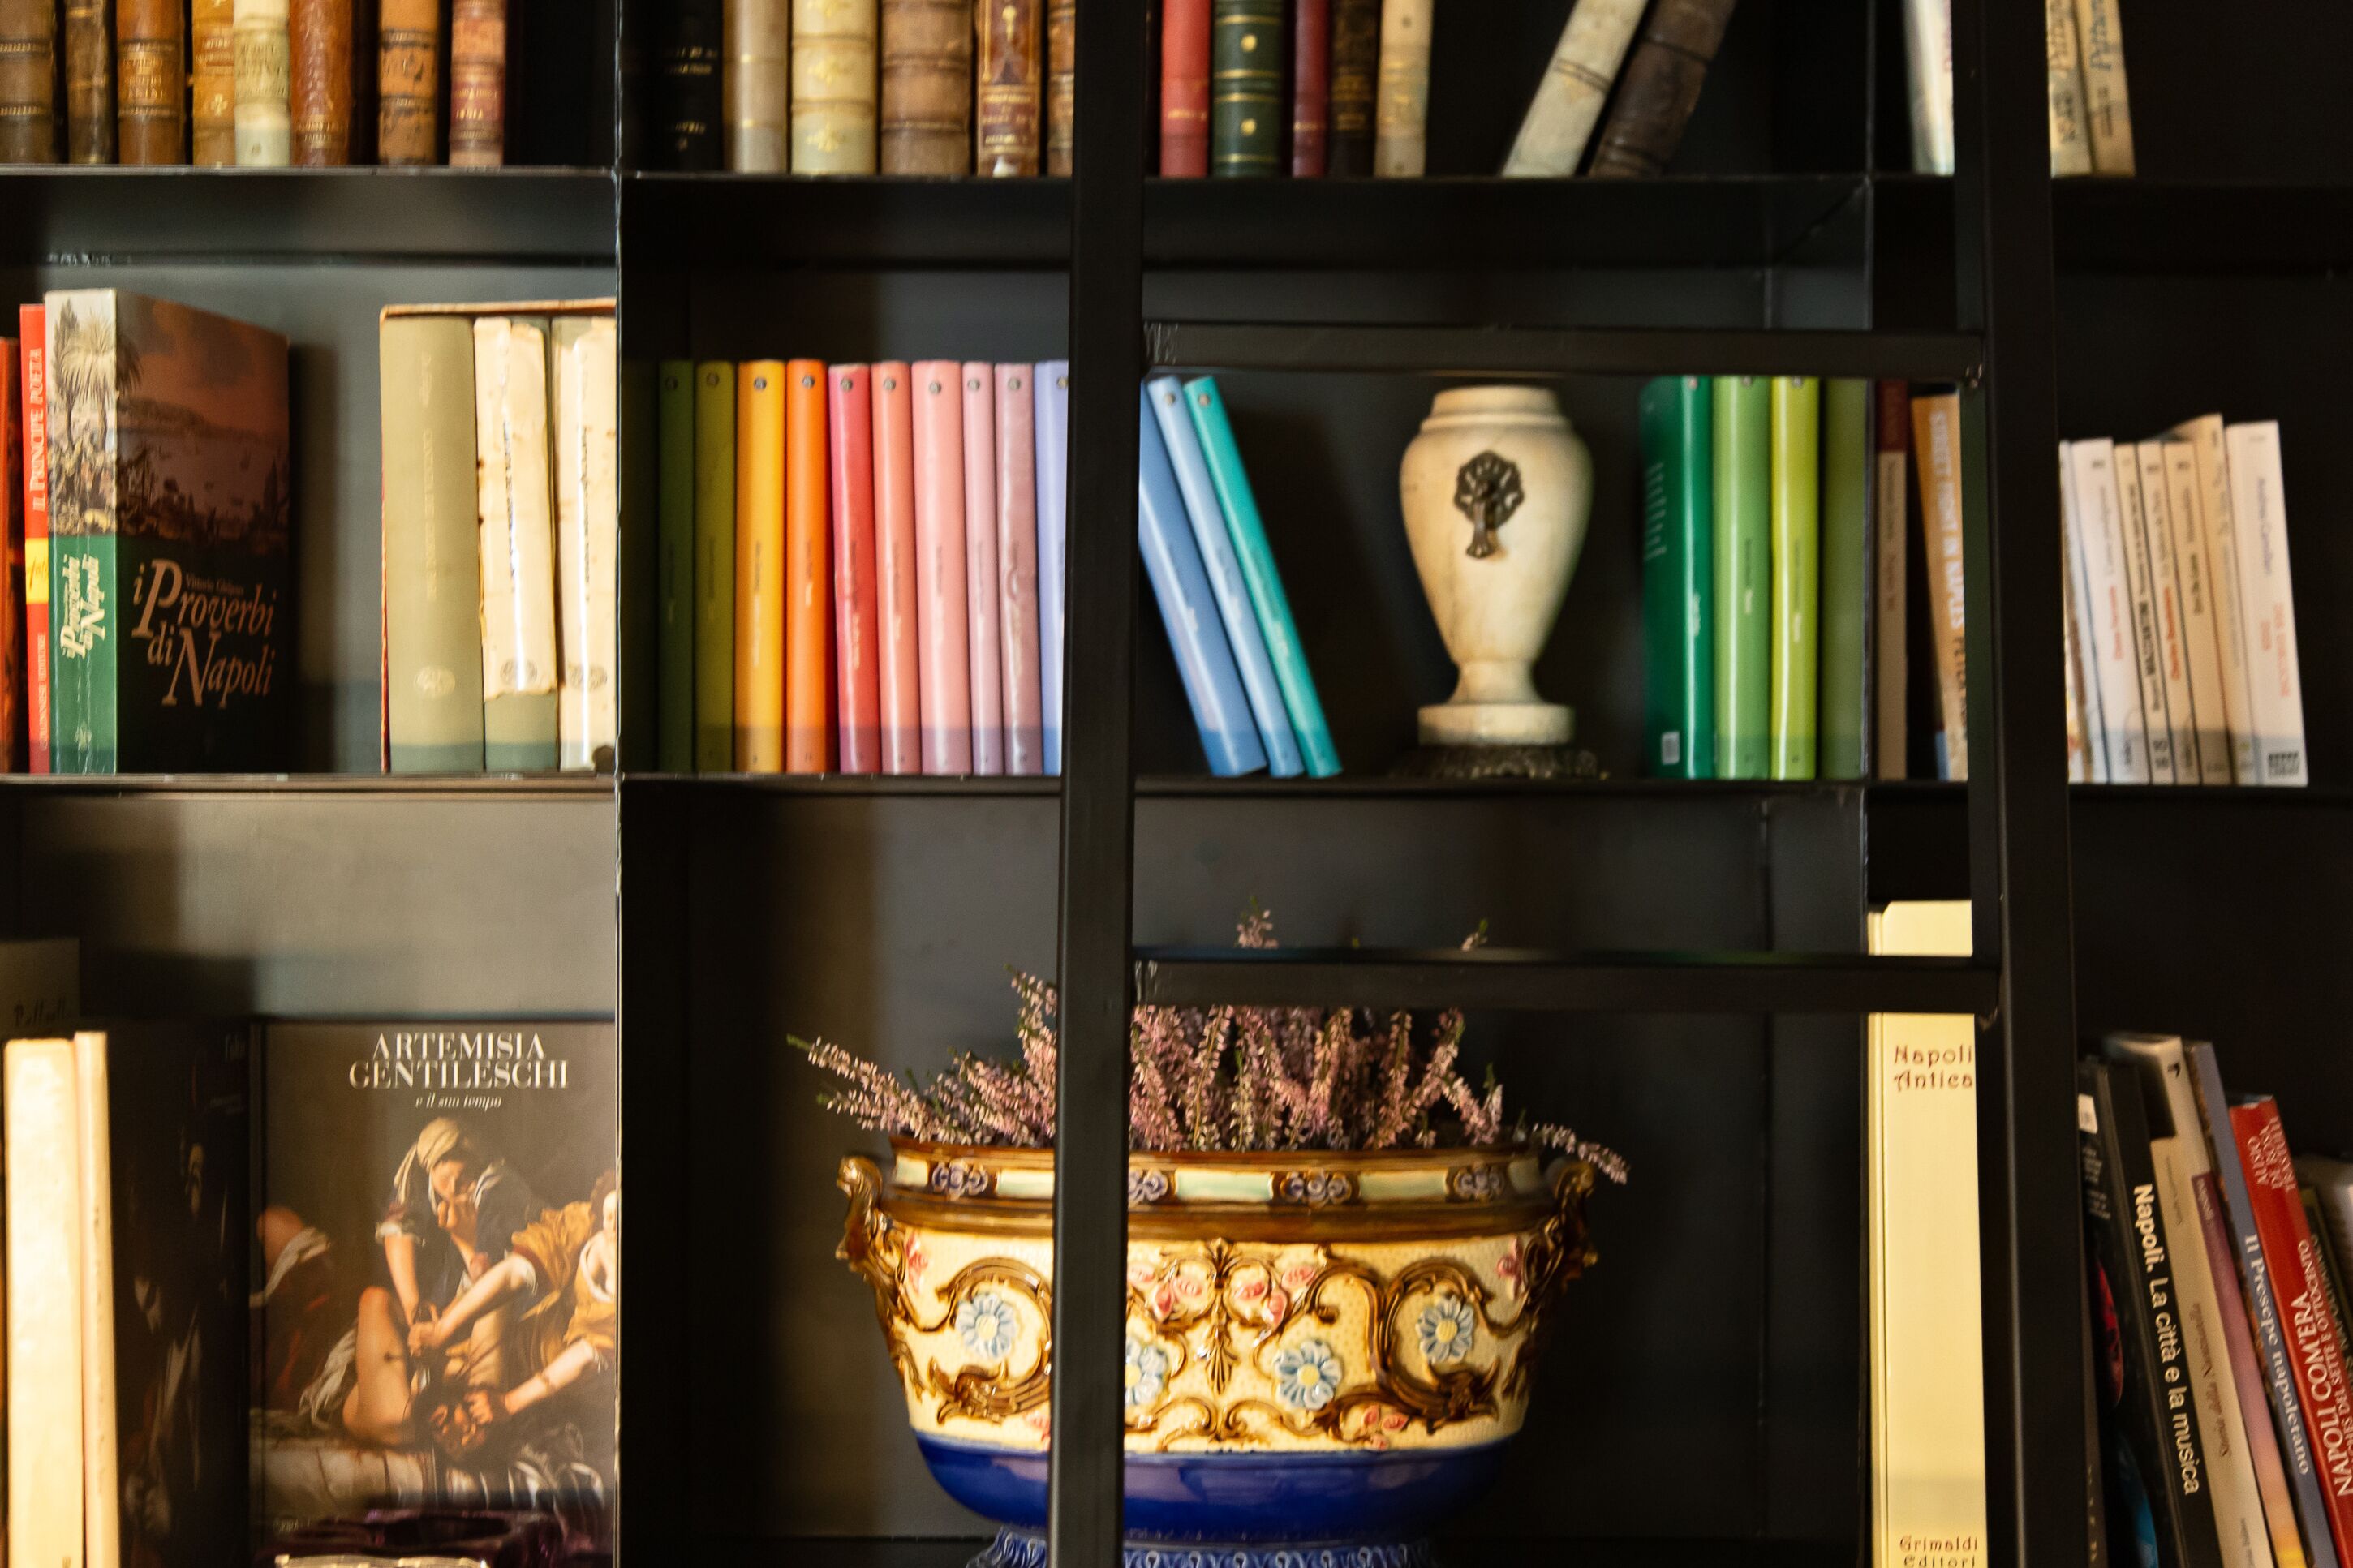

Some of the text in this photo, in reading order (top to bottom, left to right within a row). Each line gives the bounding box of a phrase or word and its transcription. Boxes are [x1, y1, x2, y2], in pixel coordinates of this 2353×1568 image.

[131, 558, 277, 639] i Proverbi
[147, 619, 276, 710] di Napoli
[372, 1031, 546, 1060] ARTEMISIA
[1894, 1044, 1972, 1069] Napoli
[349, 1059, 568, 1089] GENTILESCHI
[1894, 1070, 1972, 1092] Antica
[415, 1092, 502, 1112] e il suo tempo
[2134, 1184, 2200, 1495] Napoli. La città e la musica
[2244, 1233, 2309, 1476] Il Presepe napoletano
[2291, 1291, 2353, 1497] NAPOLI COM'ERA
[1899, 1535, 1978, 1553] Grimaldi
[1903, 1555, 1976, 1568] Editori
